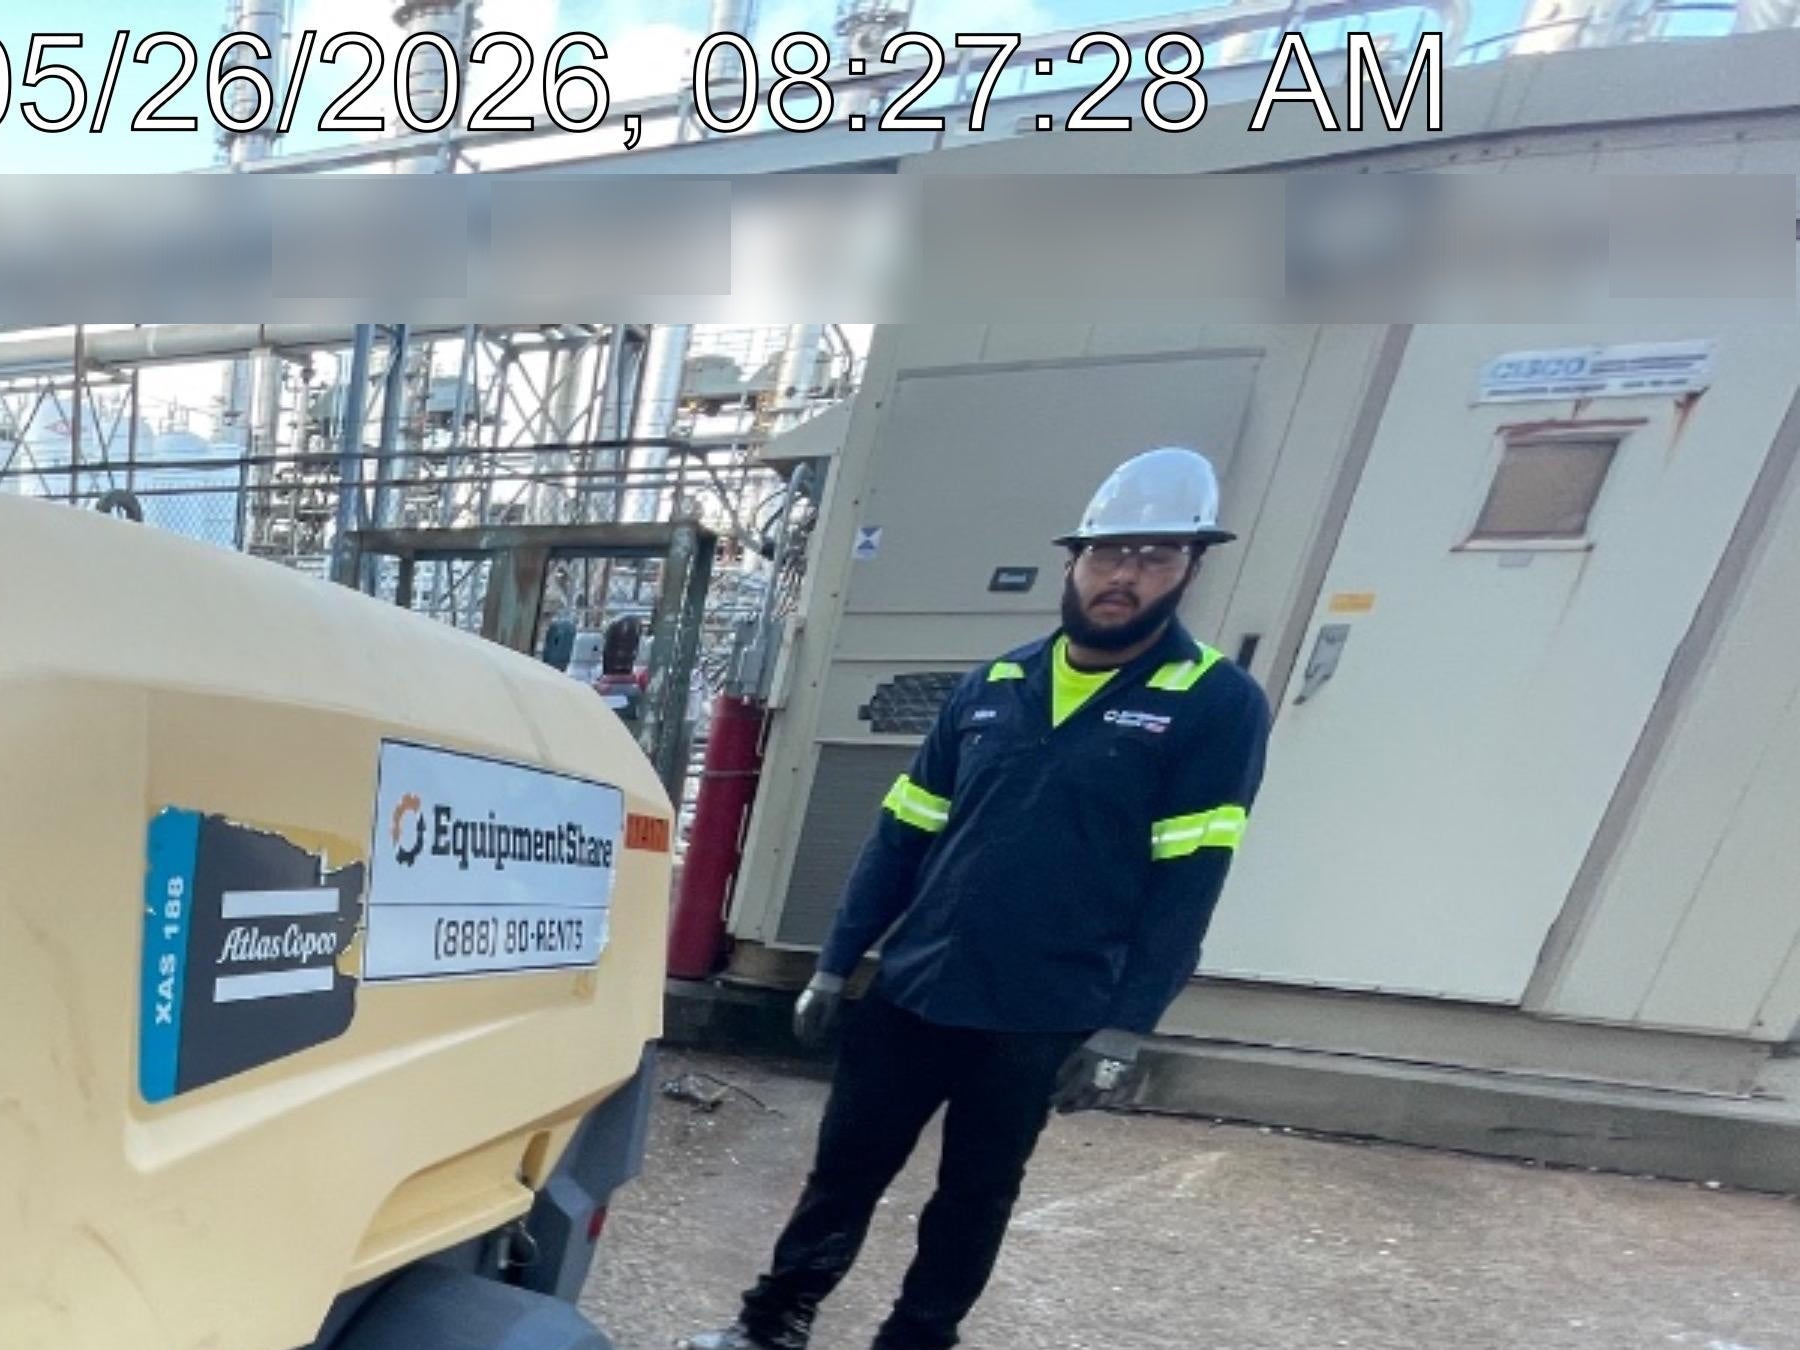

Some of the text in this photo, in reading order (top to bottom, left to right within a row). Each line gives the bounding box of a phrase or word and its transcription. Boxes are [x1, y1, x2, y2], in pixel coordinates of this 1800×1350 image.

[431, 803, 613, 871] EquipmentShare
[155, 876, 185, 1025] XAS 188
[215, 923, 338, 964] Atlas Copco
[433, 917, 584, 961] (888) 80-RENTS
